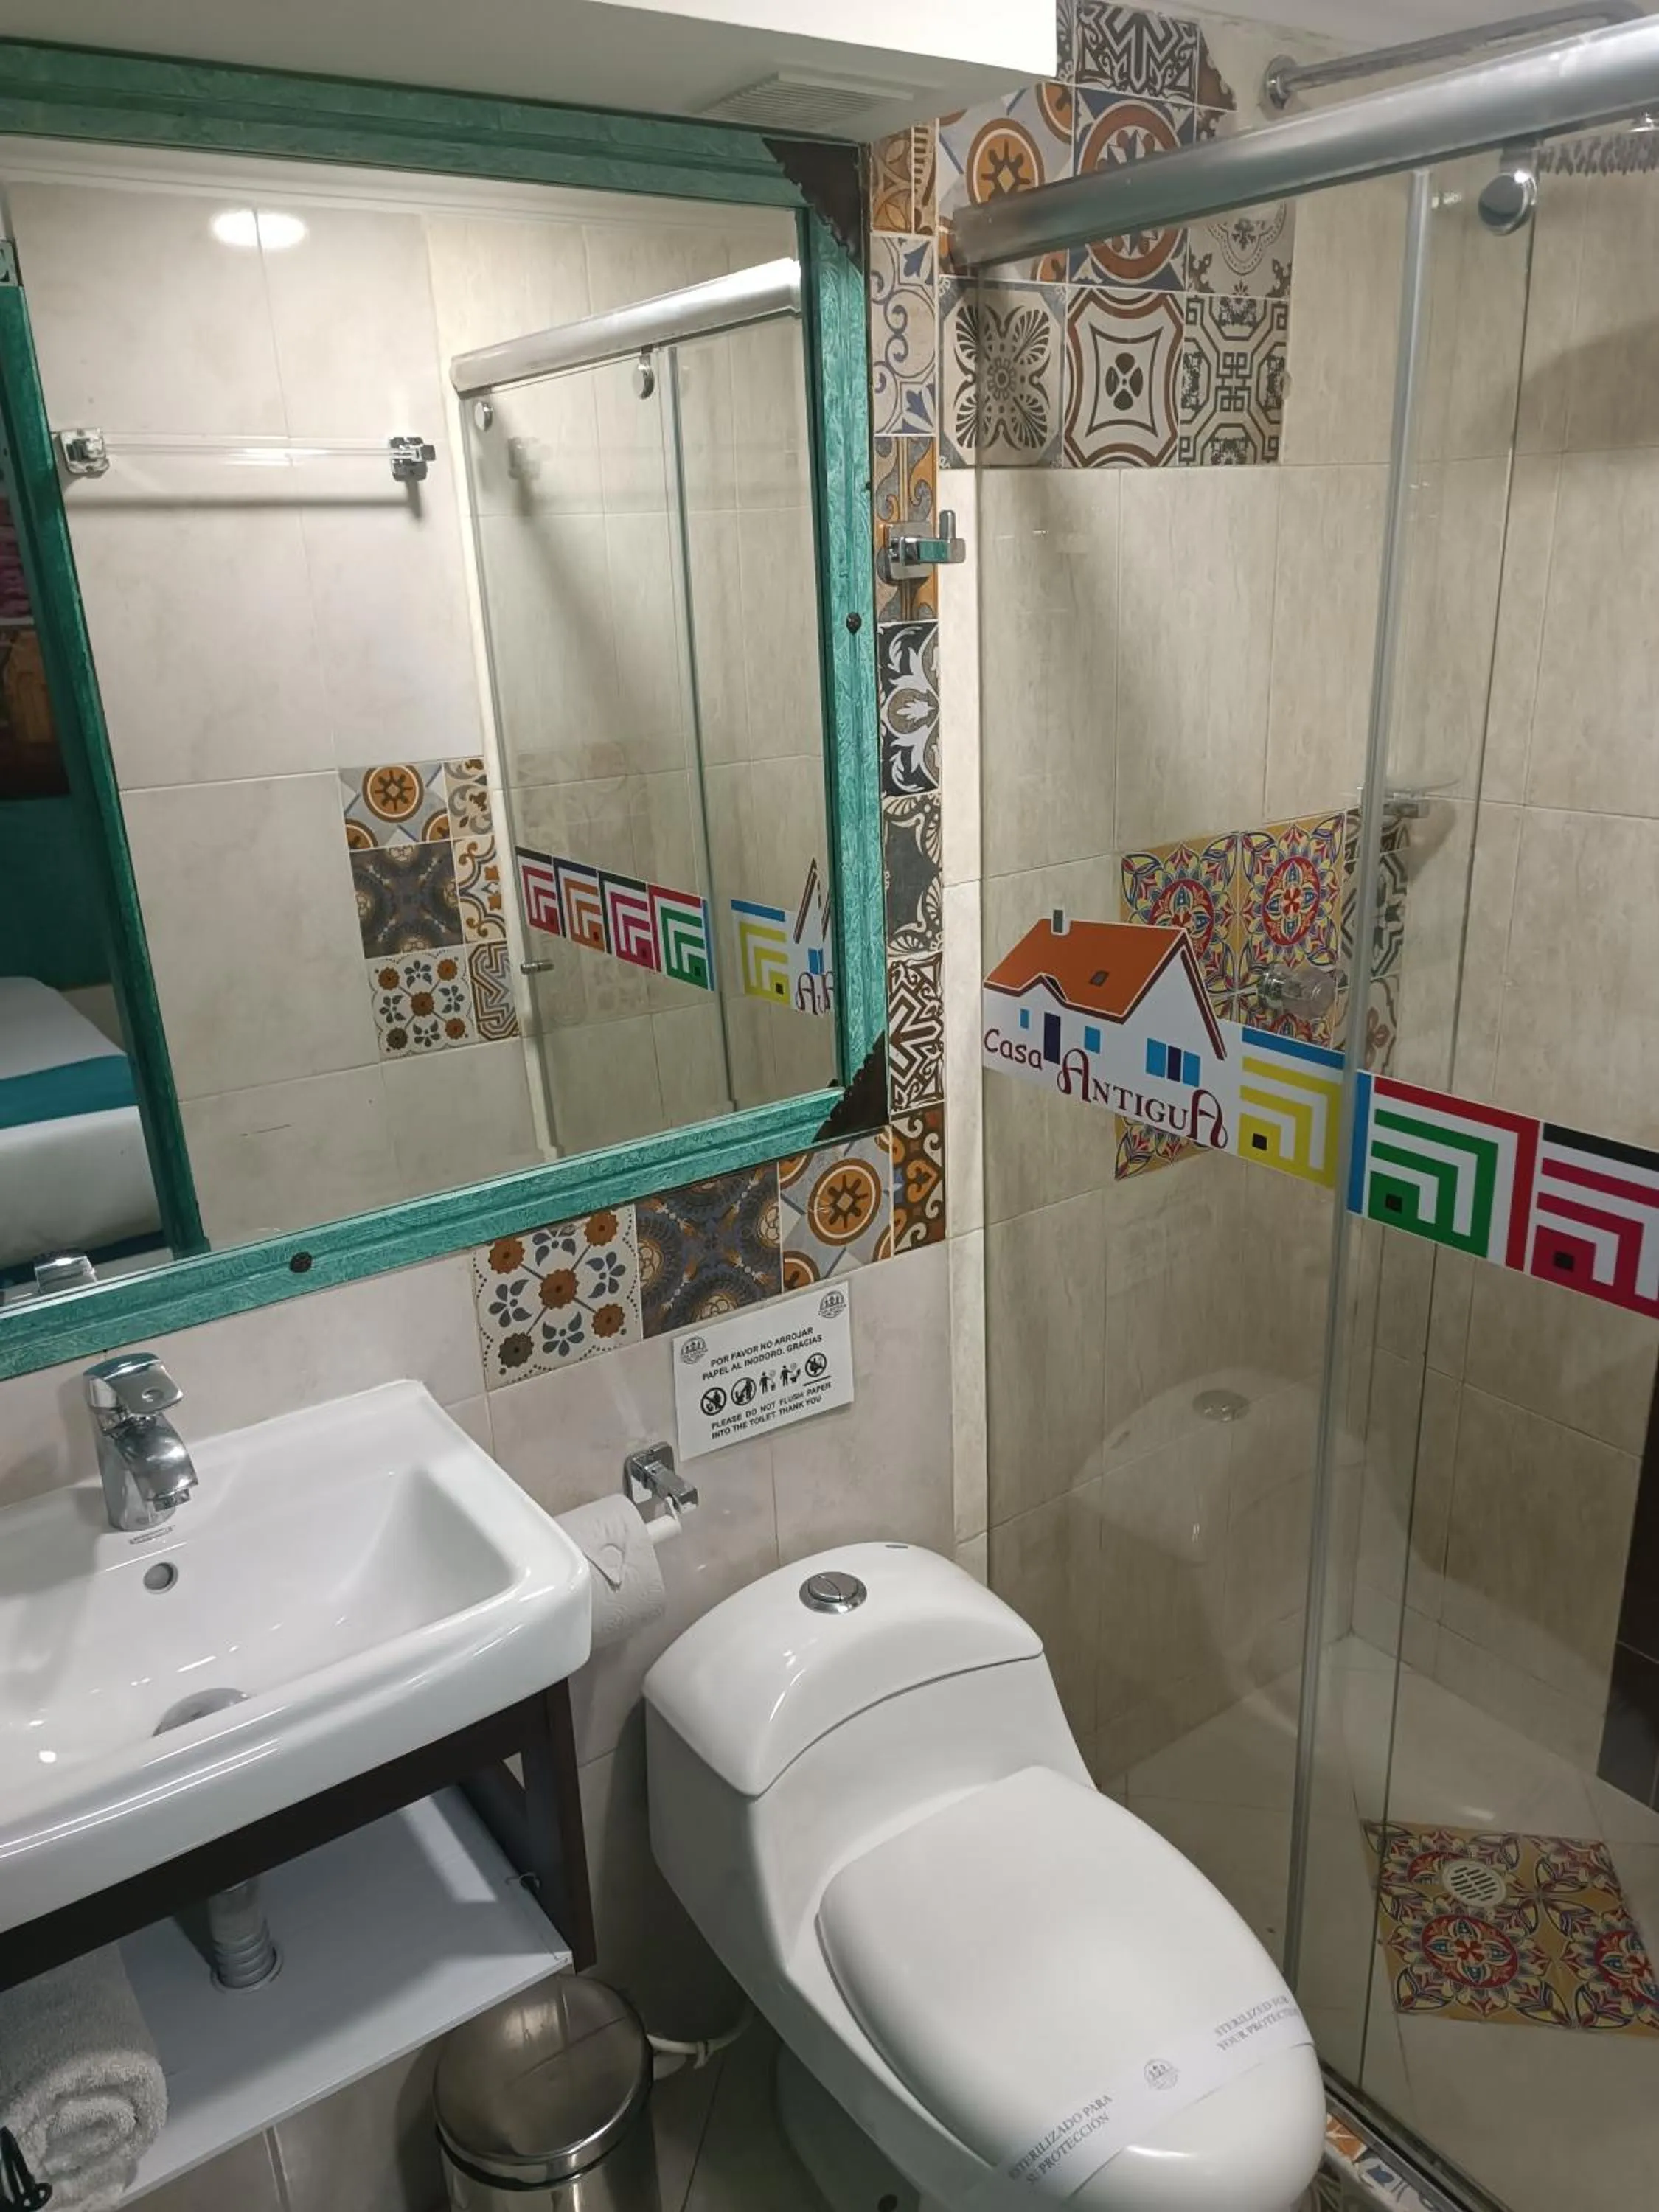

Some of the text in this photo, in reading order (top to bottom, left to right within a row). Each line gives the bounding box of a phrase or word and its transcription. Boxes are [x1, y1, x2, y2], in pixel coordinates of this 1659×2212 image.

[984, 1028, 1228, 1150] Casa ANTIGUA
[703, 1367, 729, 1380] PAPEL
[731, 1362, 742, 1371] AL
[787, 1335, 822, 1352] GRACIAS
[711, 1326, 813, 1366] POR FAVOR NO ARROJAR
[712, 1382, 831, 1429] PLEASE DO NOT FLUSH PAPER
[712, 1395, 822, 1439] INTO THE TOILET THANK YOU
[1082, 2094, 1113, 2117] PARA
